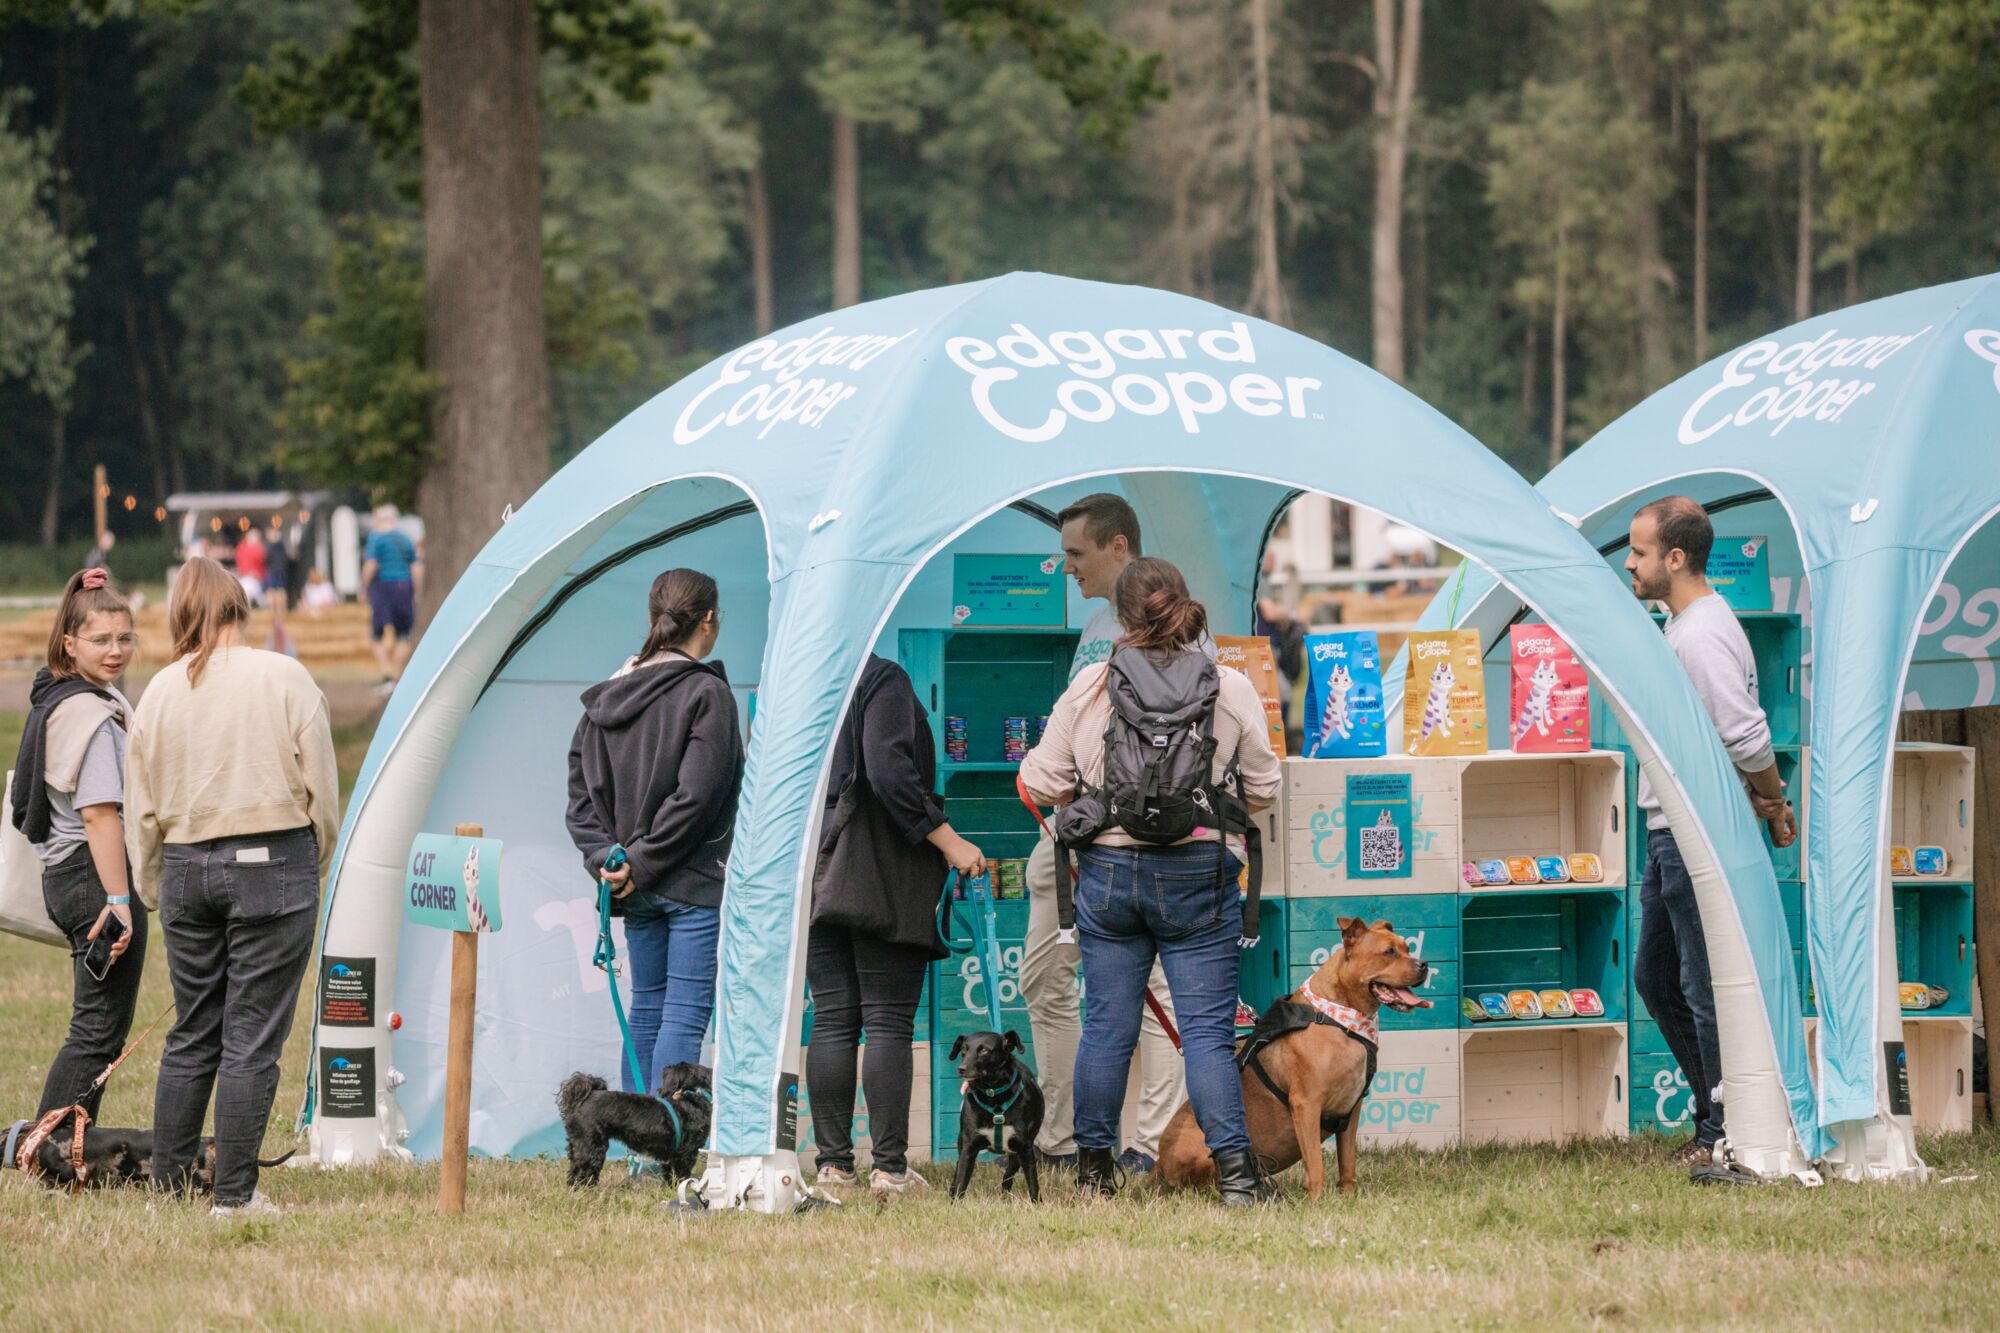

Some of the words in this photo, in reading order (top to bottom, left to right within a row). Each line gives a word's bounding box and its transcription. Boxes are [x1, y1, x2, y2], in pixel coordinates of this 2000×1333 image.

[720, 327, 918, 383] edgard
[946, 322, 1256, 378] edgard
[1723, 325, 1932, 385] edgard
[673, 371, 856, 445] Cooper
[971, 365, 1322, 442] Cooper
[1678, 374, 1875, 444] Cooper
[413, 851, 436, 878] CAT
[411, 882, 456, 911] CORNER
